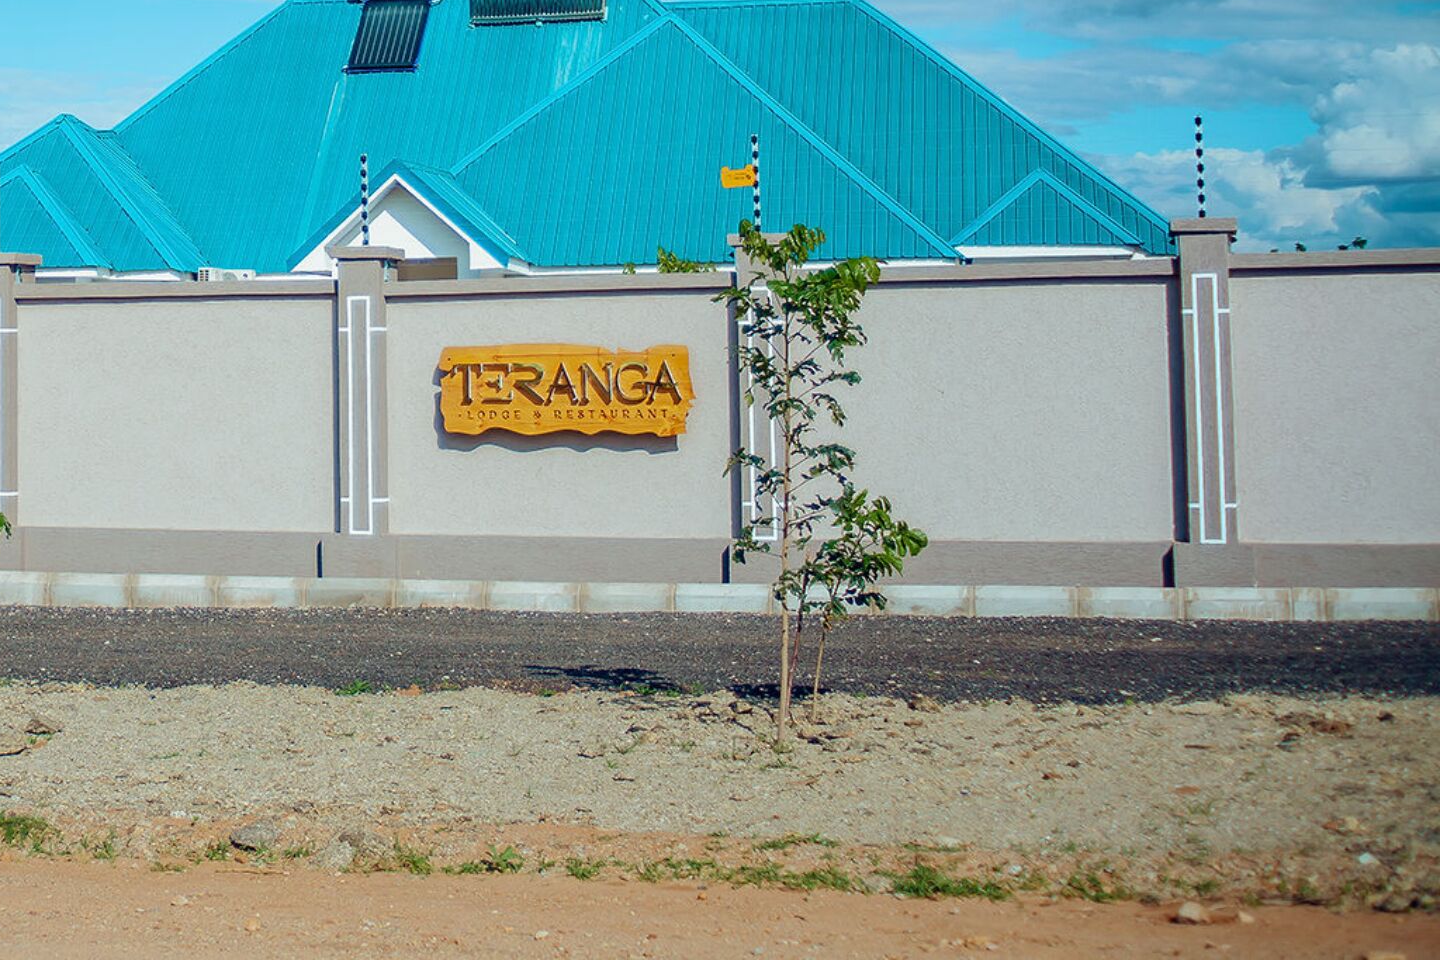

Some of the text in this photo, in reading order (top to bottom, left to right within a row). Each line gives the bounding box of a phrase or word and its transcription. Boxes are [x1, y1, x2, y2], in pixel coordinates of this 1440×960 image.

[450, 360, 682, 406] TERANGA
[466, 409, 668, 420] LODGE & RESTAURANT
